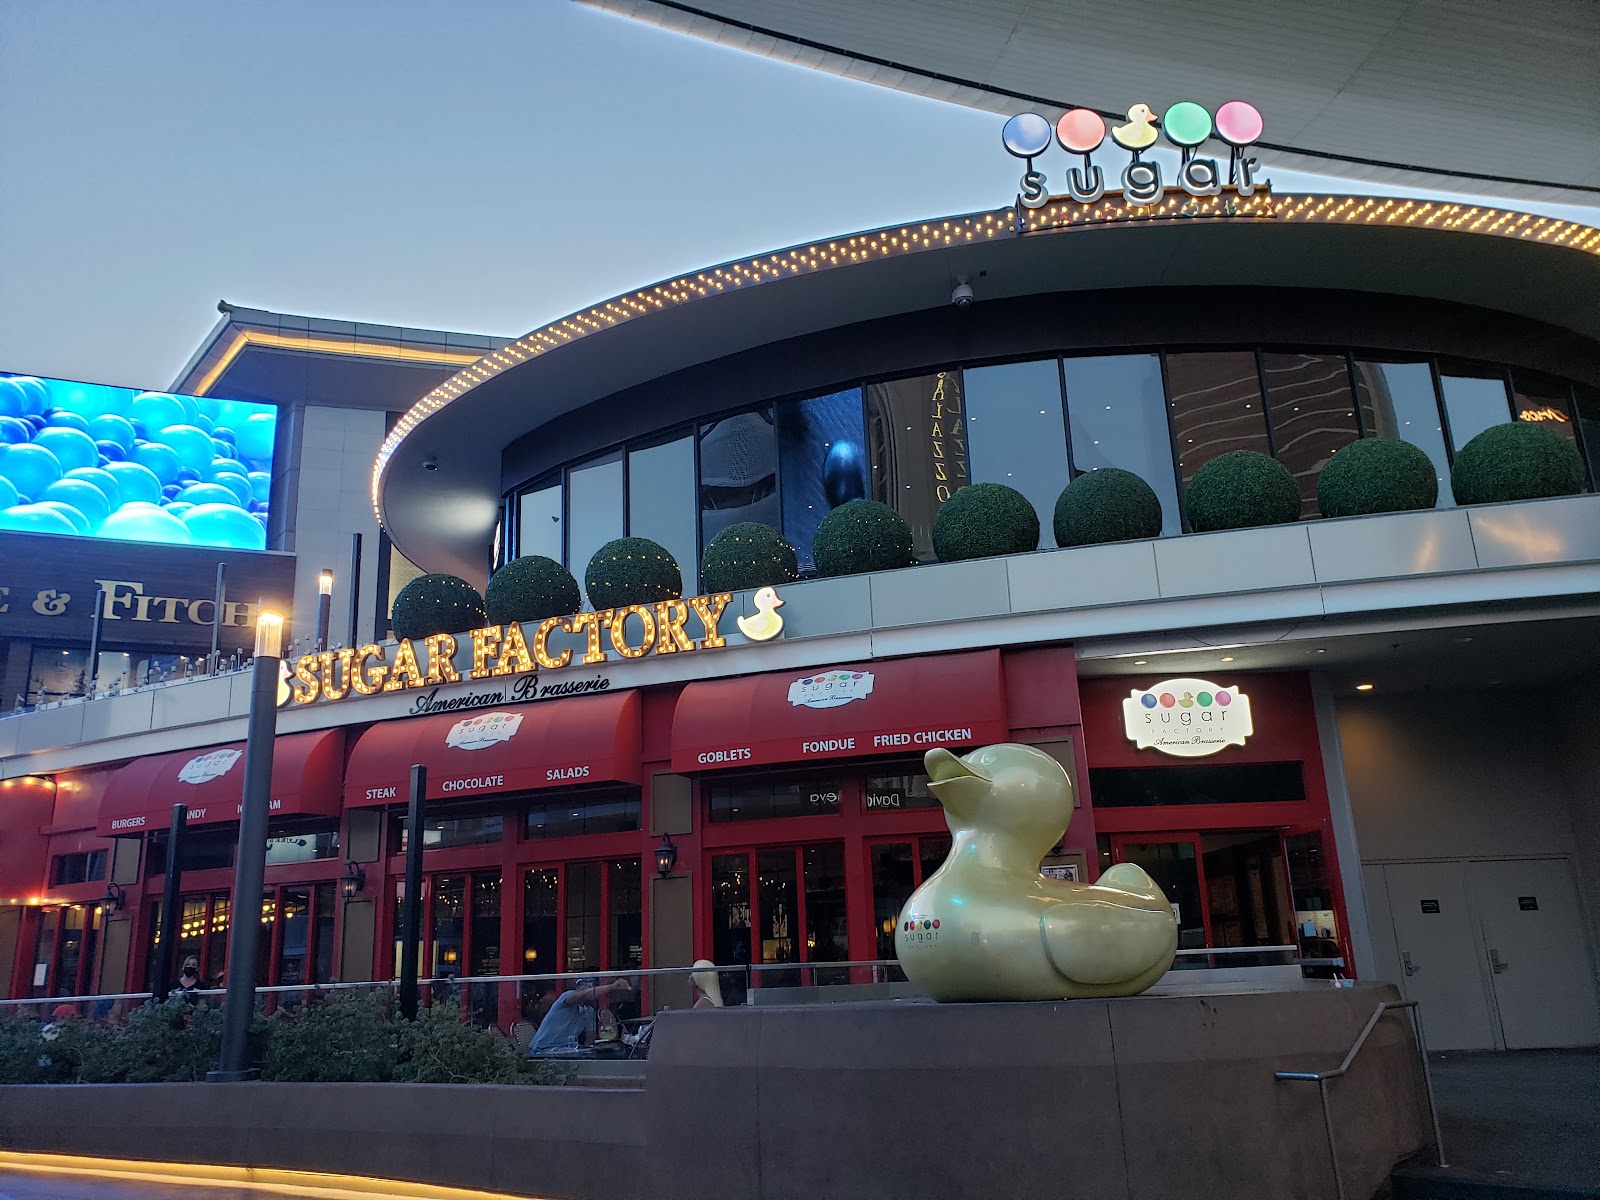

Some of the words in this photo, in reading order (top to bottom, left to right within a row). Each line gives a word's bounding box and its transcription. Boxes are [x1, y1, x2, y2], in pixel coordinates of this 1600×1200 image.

[1019, 156, 1261, 208] sugar
[32, 589, 71, 616] &
[294, 633, 463, 704] SUGAR
[469, 593, 735, 679] FACTORY
[409, 687, 505, 715] American
[511, 674, 611, 701] Brasserie
[1144, 709, 1228, 726] sugar
[873, 734, 911, 748] FRIED
[913, 728, 972, 744] CHICKEN
[1151, 726, 1225, 734] FACTORY
[802, 738, 855, 754] FONDUE
[697, 748, 752, 764] GOBLETS
[546, 765, 590, 781] SALADS
[442, 775, 504, 792] CHOCOLATE
[365, 786, 397, 800] STEAK
[186, 808, 207, 820] ANDY
[111, 816, 146, 830] BURGERS
[904, 932, 939, 943] sugar
